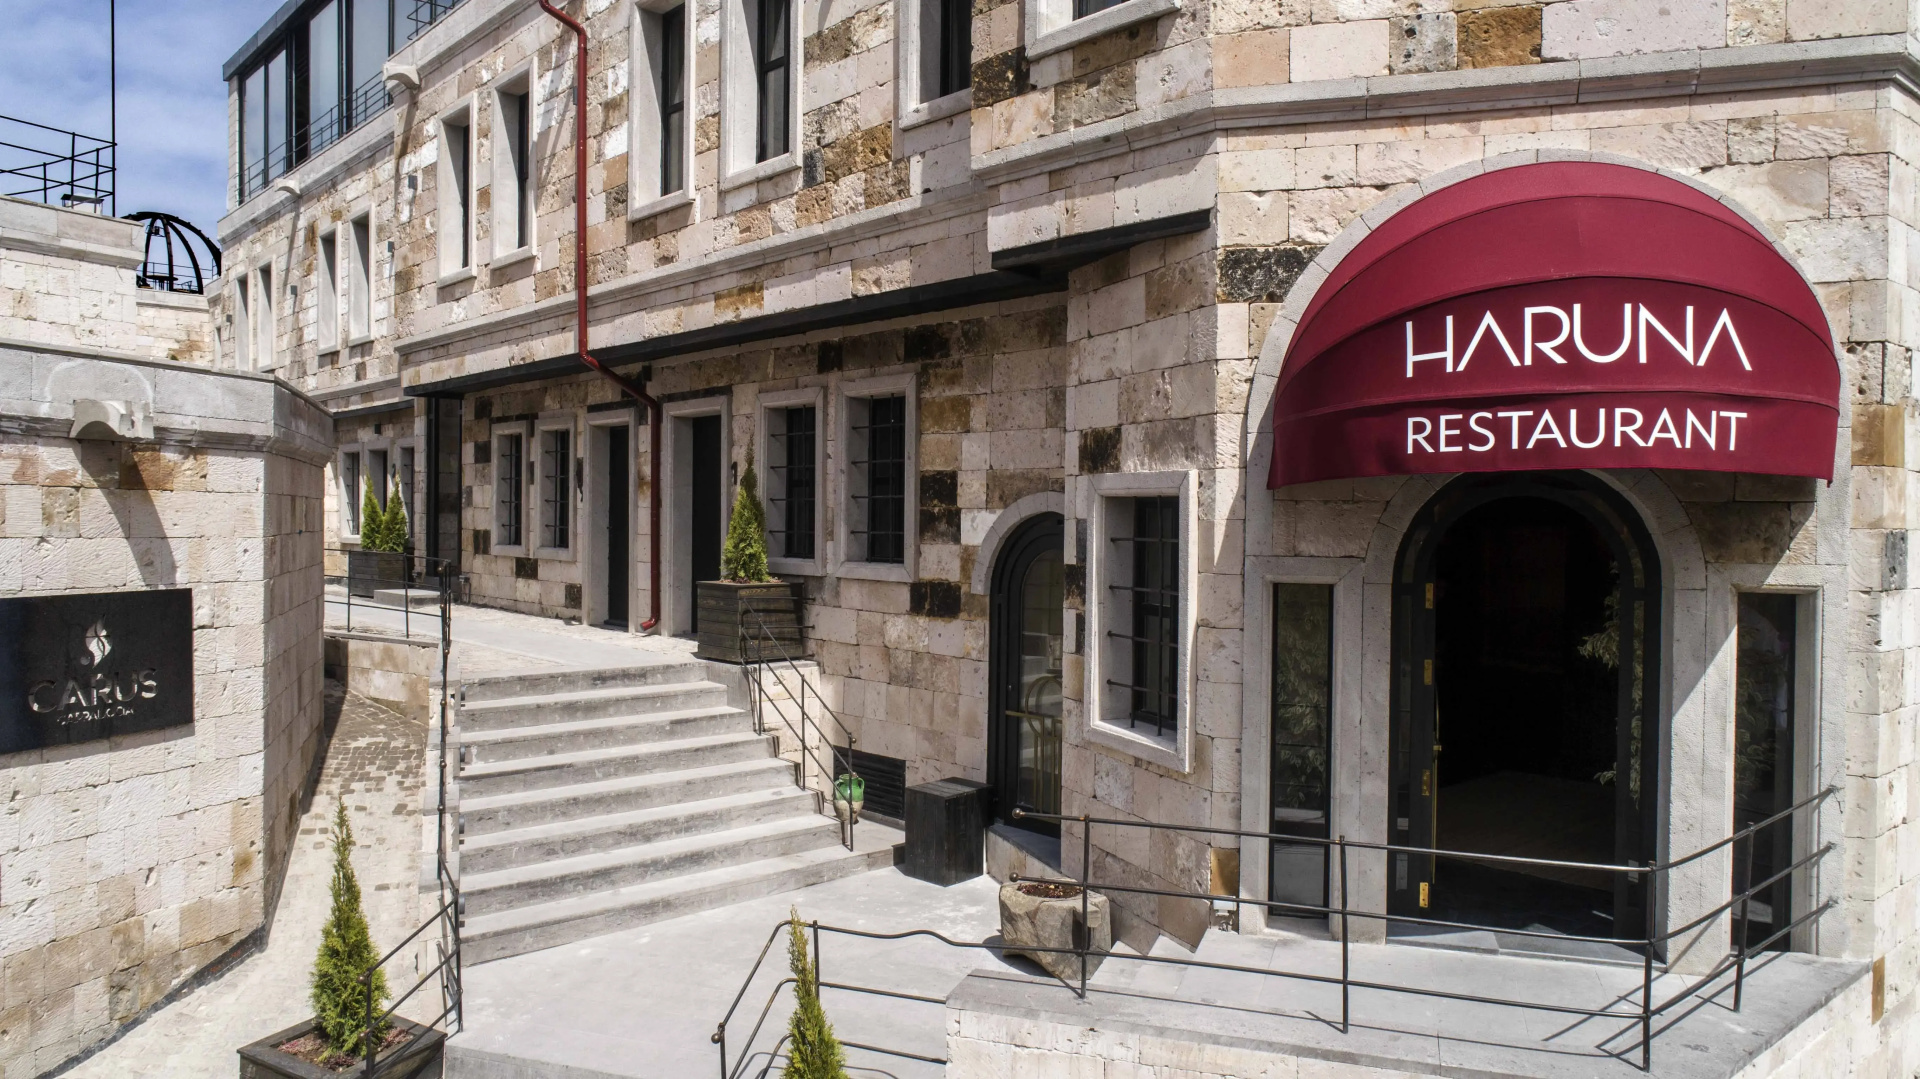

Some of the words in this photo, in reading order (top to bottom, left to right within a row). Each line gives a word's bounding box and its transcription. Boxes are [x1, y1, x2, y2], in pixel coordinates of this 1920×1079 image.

[1406, 303, 1752, 377] HARUNA
[1407, 407, 1748, 454] RESTAURANT
[28, 668, 158, 713] CARUS
